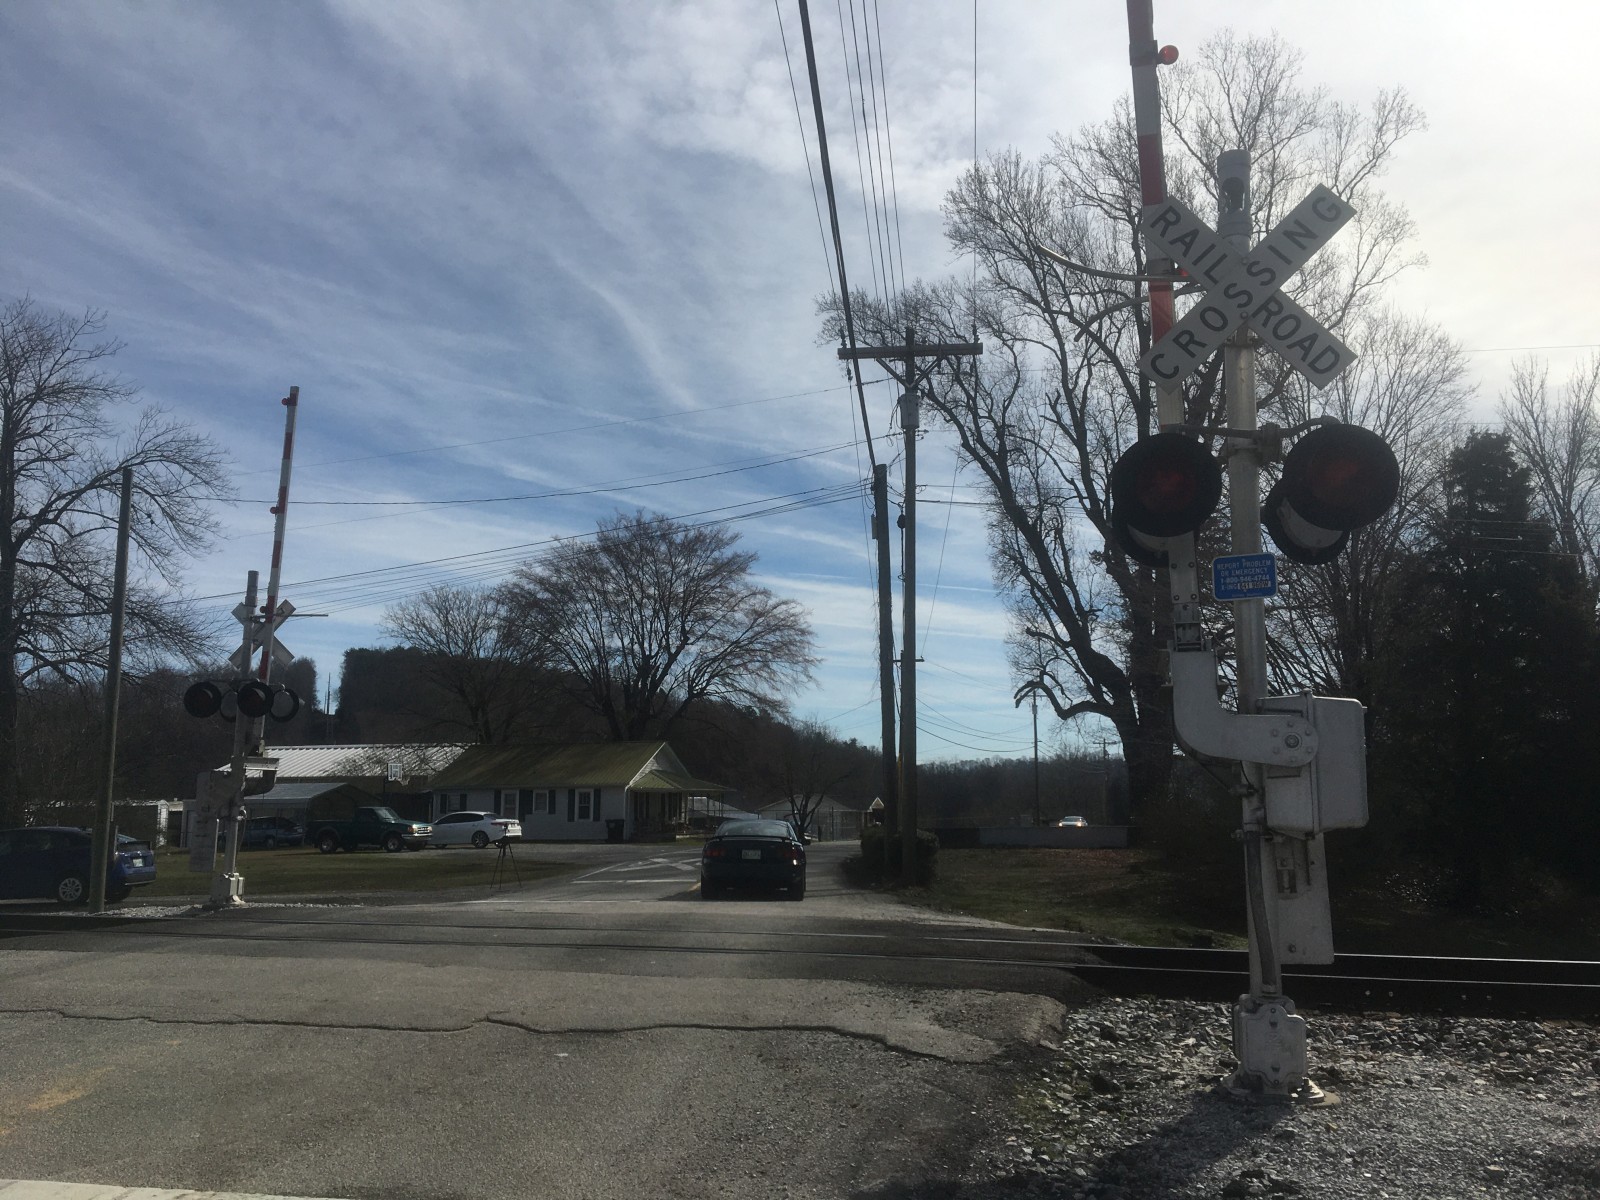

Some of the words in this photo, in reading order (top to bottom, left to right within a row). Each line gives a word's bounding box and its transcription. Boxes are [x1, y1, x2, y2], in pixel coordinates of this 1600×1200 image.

[1150, 196, 1342, 380] CROSSING
[1150, 205, 1228, 285] RAIL
[1251, 295, 1340, 375] ROAD
[1216, 562, 1240, 570] REPORT
[1242, 559, 1271, 568] PROBLEM
[1231, 567, 1268, 576] EMERGENCY
